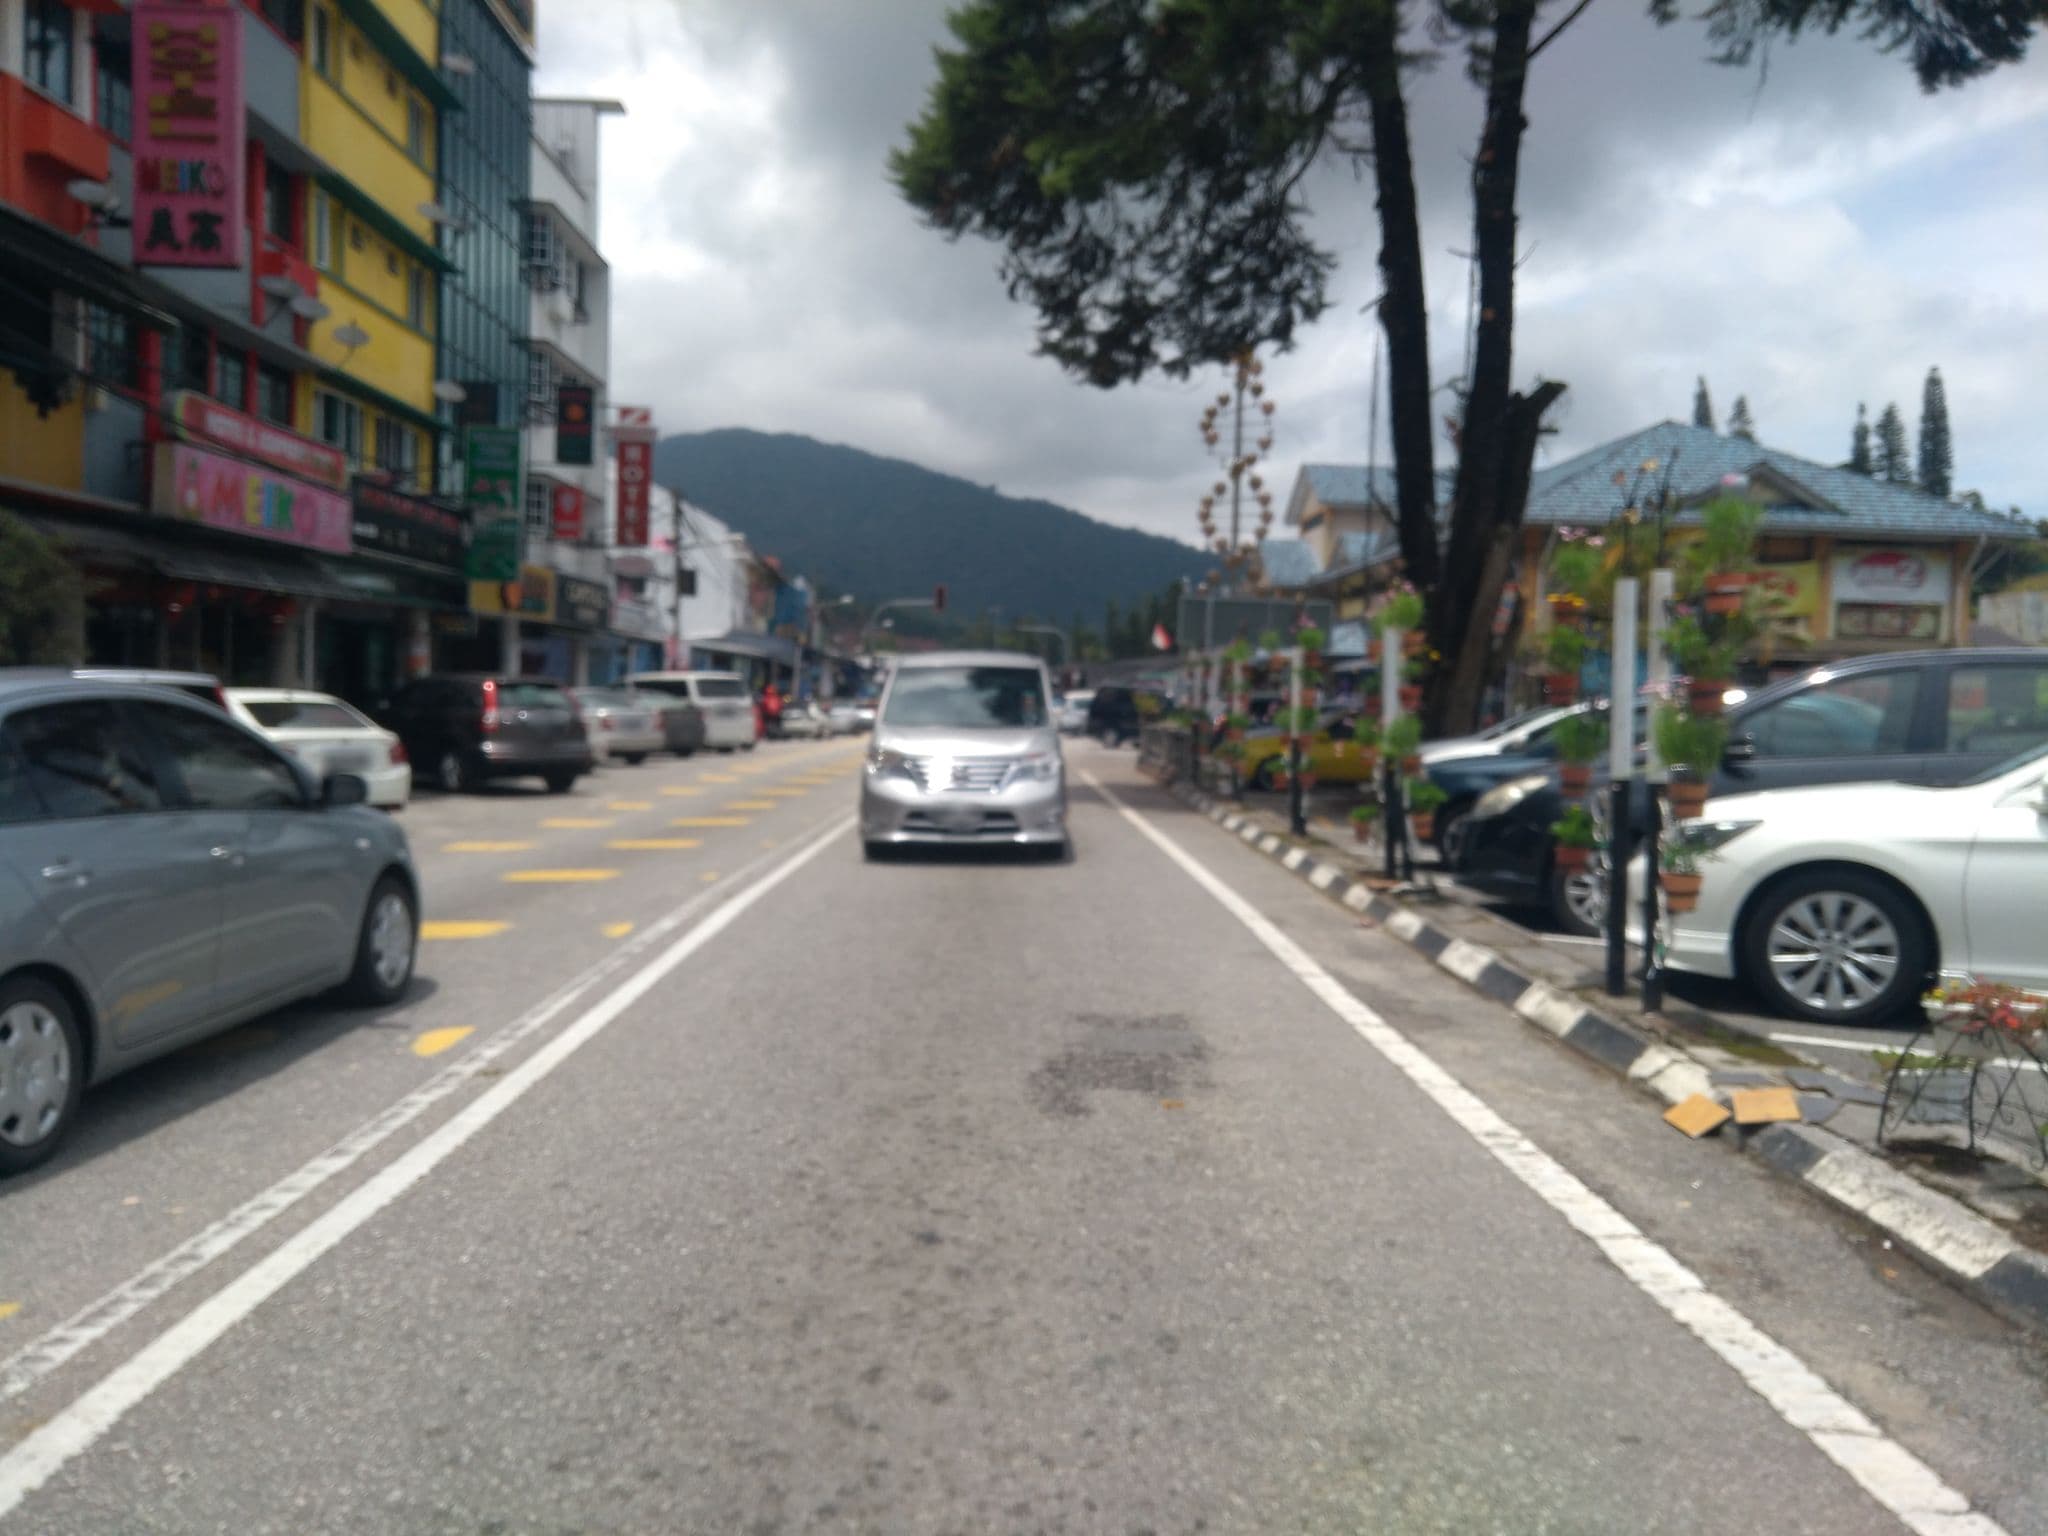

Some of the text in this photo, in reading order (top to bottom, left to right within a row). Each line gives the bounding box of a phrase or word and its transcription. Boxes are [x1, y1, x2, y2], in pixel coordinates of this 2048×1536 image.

[138, 159, 224, 196] MEIKO
[211, 473, 316, 534] MEIKO
[622, 446, 645, 543] HOTEL
